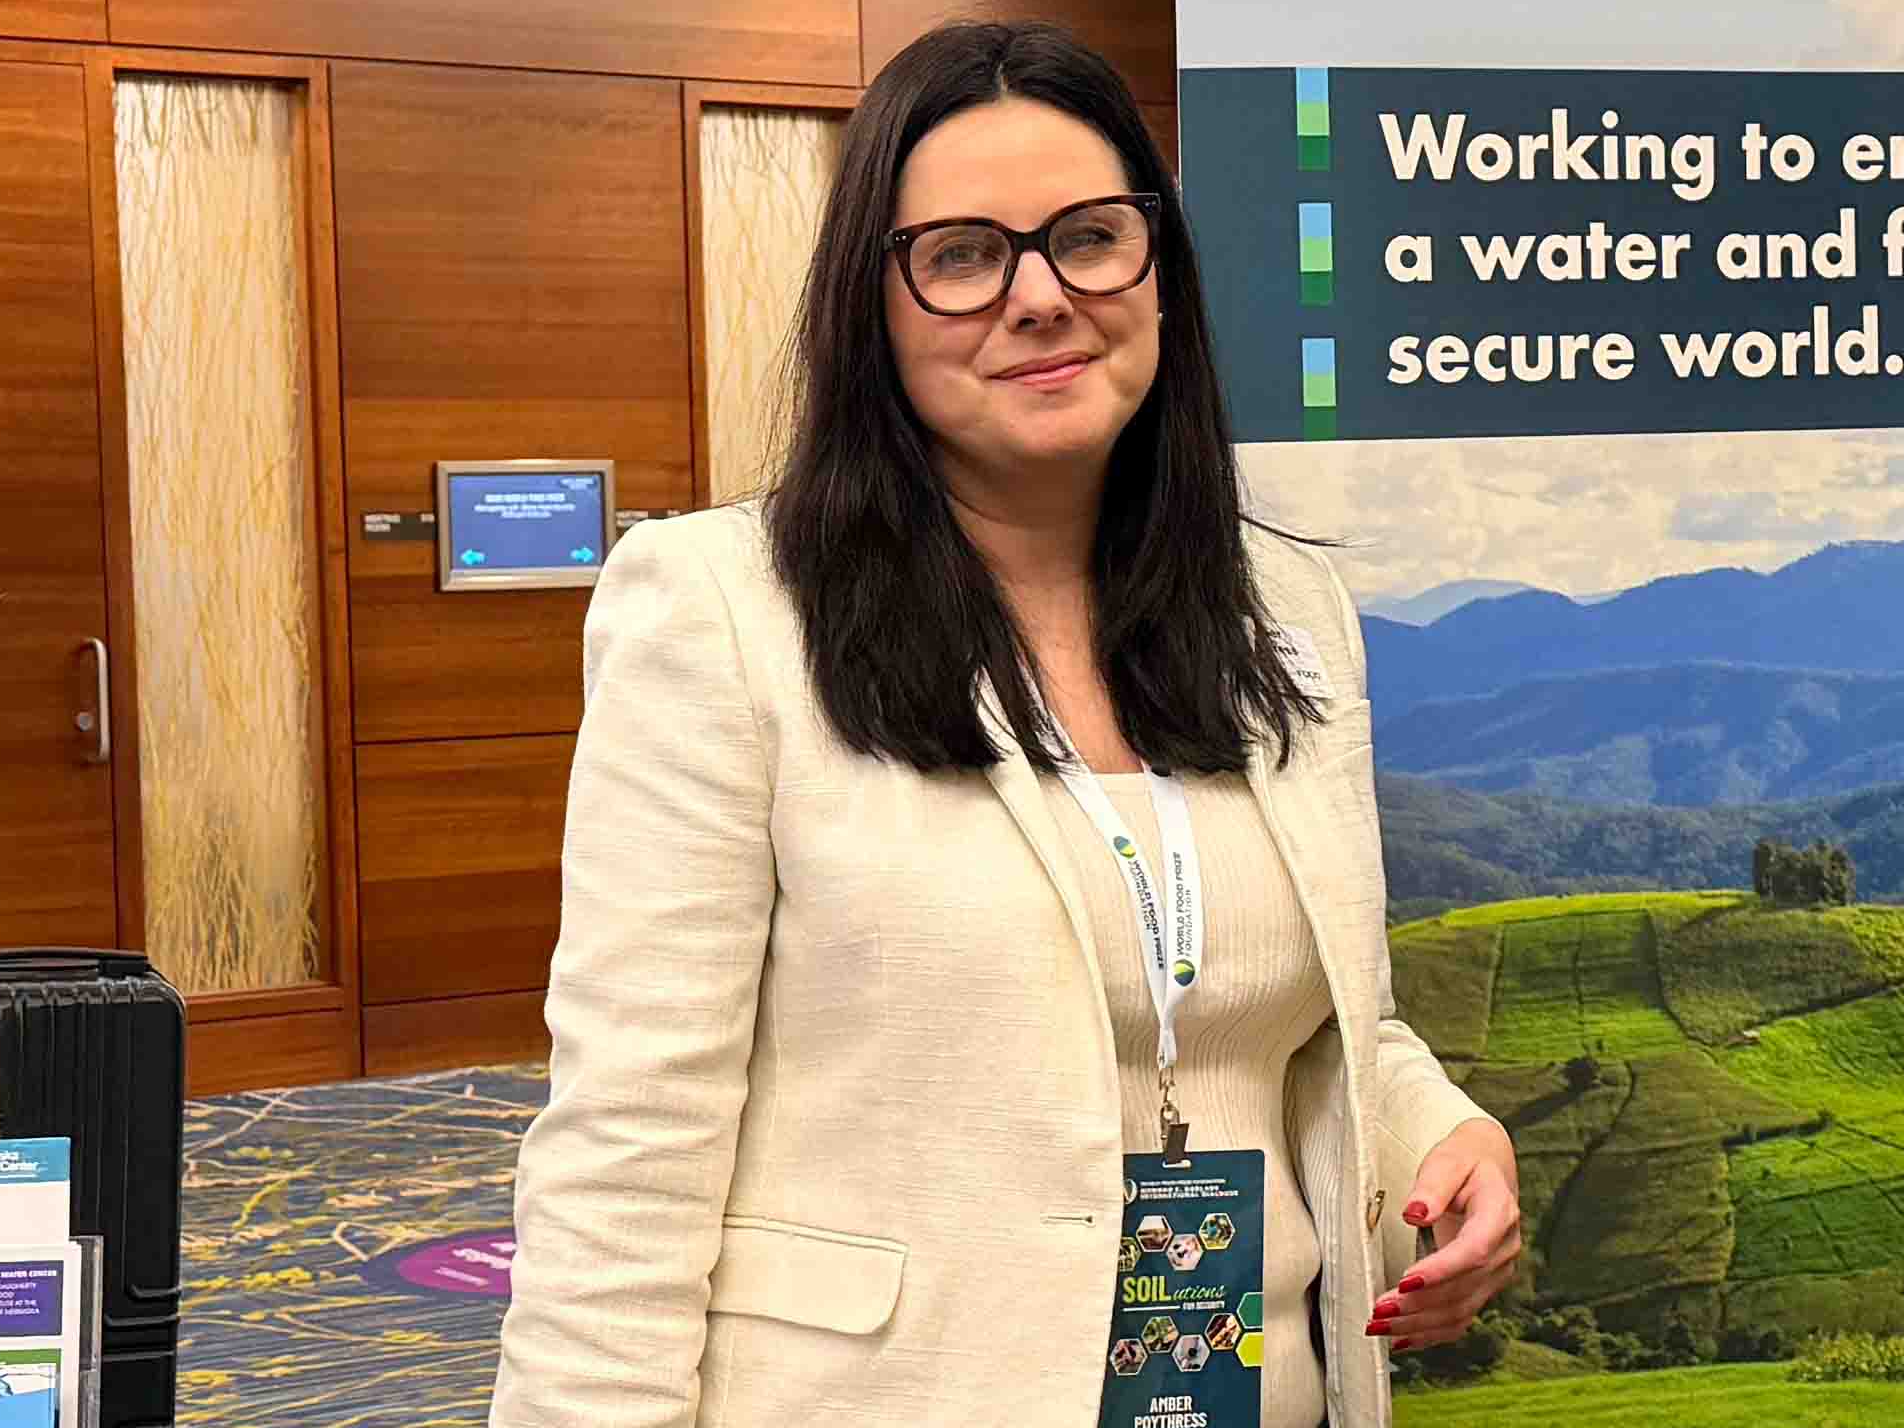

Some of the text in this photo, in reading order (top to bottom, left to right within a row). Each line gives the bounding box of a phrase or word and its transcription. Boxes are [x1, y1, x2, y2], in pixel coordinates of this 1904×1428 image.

[1378, 108, 1716, 200] Working
[1743, 122, 1815, 181] to
[1384, 229, 1433, 281] a
[1460, 223, 1690, 281] water
[1716, 209, 1856, 280] and
[1386, 308, 1904, 384] secure world.
[1150, 1395, 1192, 1413] AMBER
